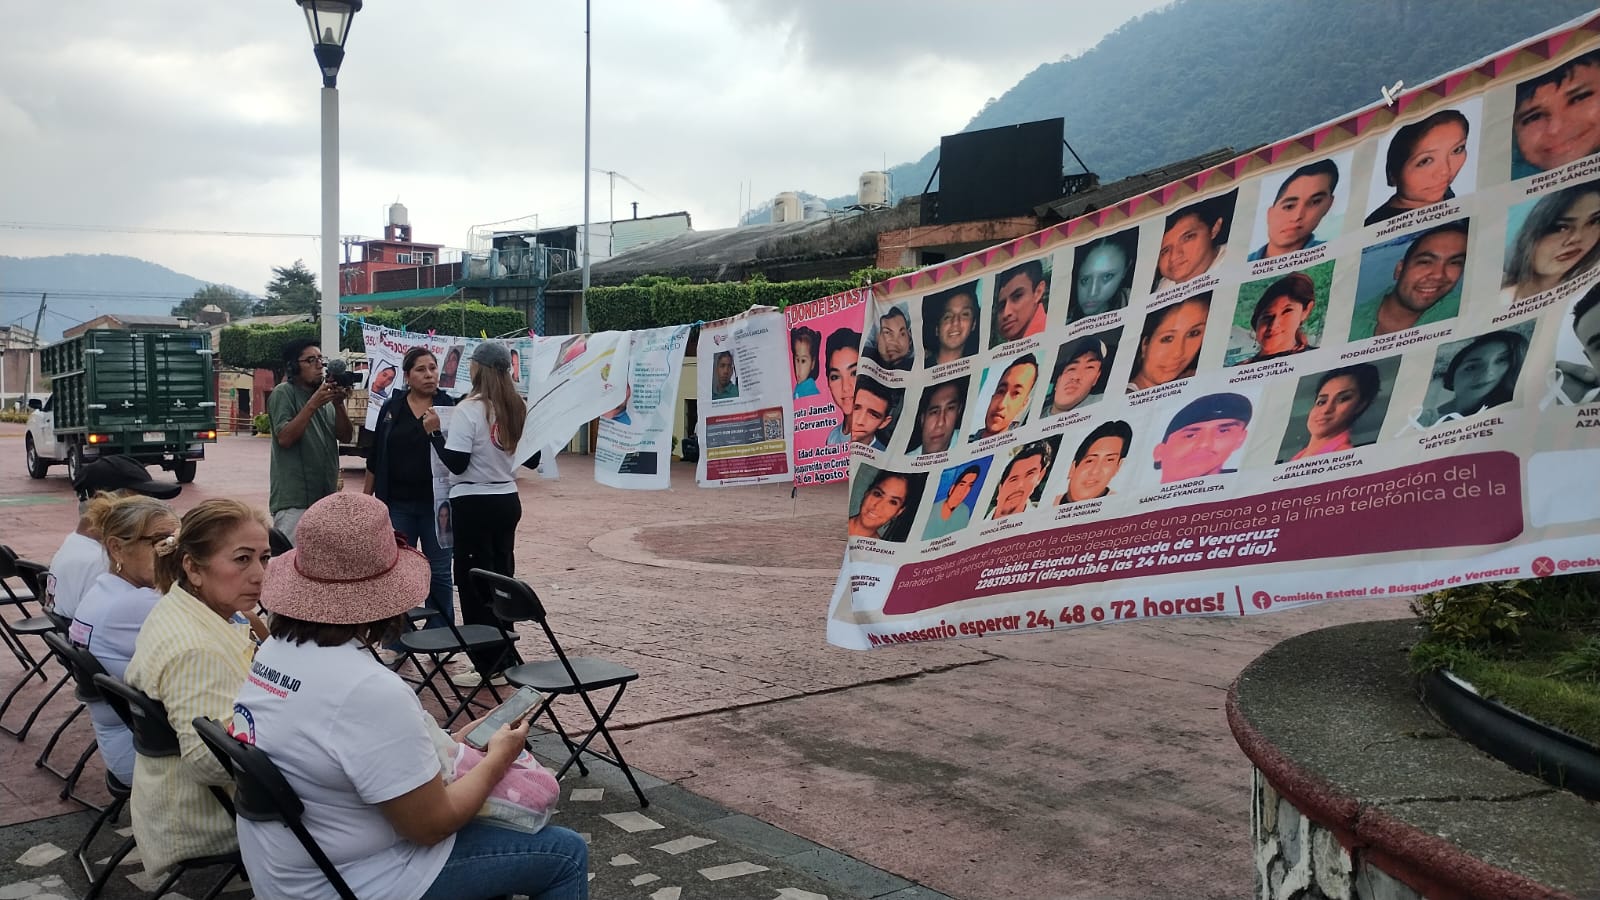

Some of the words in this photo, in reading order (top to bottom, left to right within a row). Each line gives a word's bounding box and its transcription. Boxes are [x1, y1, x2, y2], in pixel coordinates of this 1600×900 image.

[1531, 169, 1564, 185] FREDY
[1526, 179, 1558, 195] REYES
[1386, 213, 1414, 227] JENNY
[1416, 202, 1450, 218] ISABEL
[1252, 256, 1287, 268] AURELIO
[1289, 245, 1327, 260] ALFONSO
[1277, 252, 1325, 270] CASTAÑEDA
[1398, 329, 1420, 342] LUIS
[1238, 367, 1255, 375] ANA
[1257, 361, 1289, 372] CRISTEL
[1229, 373, 1264, 384] ROMERO
[800, 418, 837, 430] Cervantes
[1418, 428, 1463, 445] CLAUDIA
[1465, 417, 1504, 431] GUICEL
[1425, 437, 1457, 450] REYES
[1459, 428, 1494, 441] REYES
[815, 445, 840, 456] Actual
[1332, 452, 1354, 464] RUBÍ
[814, 470, 844, 483] Agosto
[1272, 468, 1324, 482] CABALLERO
[1325, 459, 1363, 472] ACOSTA
[1160, 480, 1204, 493] ALEJANDRO
[1173, 484, 1224, 498] EVANGELISTA
[990, 541, 1026, 556] reporte
[1027, 537, 1047, 551] por
[1048, 535, 1058, 545] la
[1060, 521, 1137, 544] desaparición
[1140, 518, 1158, 530] de
[1161, 514, 1187, 527] una
[1190, 506, 1252, 525] persona
[1256, 504, 1267, 513] o
[1271, 492, 1321, 511] tienes
[1326, 471, 1437, 503] información
[1443, 463, 1477, 481] del
[1073, 501, 1103, 511] ANTONIO
[995, 548, 1046, 566] reportada
[1050, 543, 1082, 556] como
[1084, 528, 1172, 551] desaparecida,
[1271, 514, 1281, 524] a
[1285, 510, 1299, 522] la
[1350, 485, 1446, 512] telefónica
[1452, 482, 1481, 498] de
[1488, 479, 1506, 496] la
[980, 558, 1030, 578] Comisión
[1031, 554, 1076, 571] Estatal
[1078, 550, 1096, 564] de
[1098, 540, 1170, 562] Búsqueda
[1173, 537, 1194, 550] de
[1199, 527, 1280, 547] Veracruz:
[1035, 561, 1108, 583] (disponible
[1110, 557, 1133, 572] las
[1134, 556, 1155, 568] 24
[1157, 552, 1203, 566] horas
[1206, 544, 1233, 559] del
[1237, 540, 1278, 557] día).
[1273, 591, 1323, 603] Comisión
[1326, 587, 1366, 599] Estatal
[1370, 585, 1385, 595] de
[1388, 577, 1445, 594] Búsqueda
[1447, 574, 1462, 585] de
[1465, 565, 1520, 581] Veracruz
[894, 619, 957, 645] necesario
[959, 615, 1021, 638] esperar
[1026, 609, 1055, 630] 24,
[1059, 604, 1086, 624] 48
[1090, 606, 1105, 622] o
[1110, 599, 1138, 620] 72
[1143, 592, 1225, 617] horas!
[280, 673, 301, 692] HIJO
